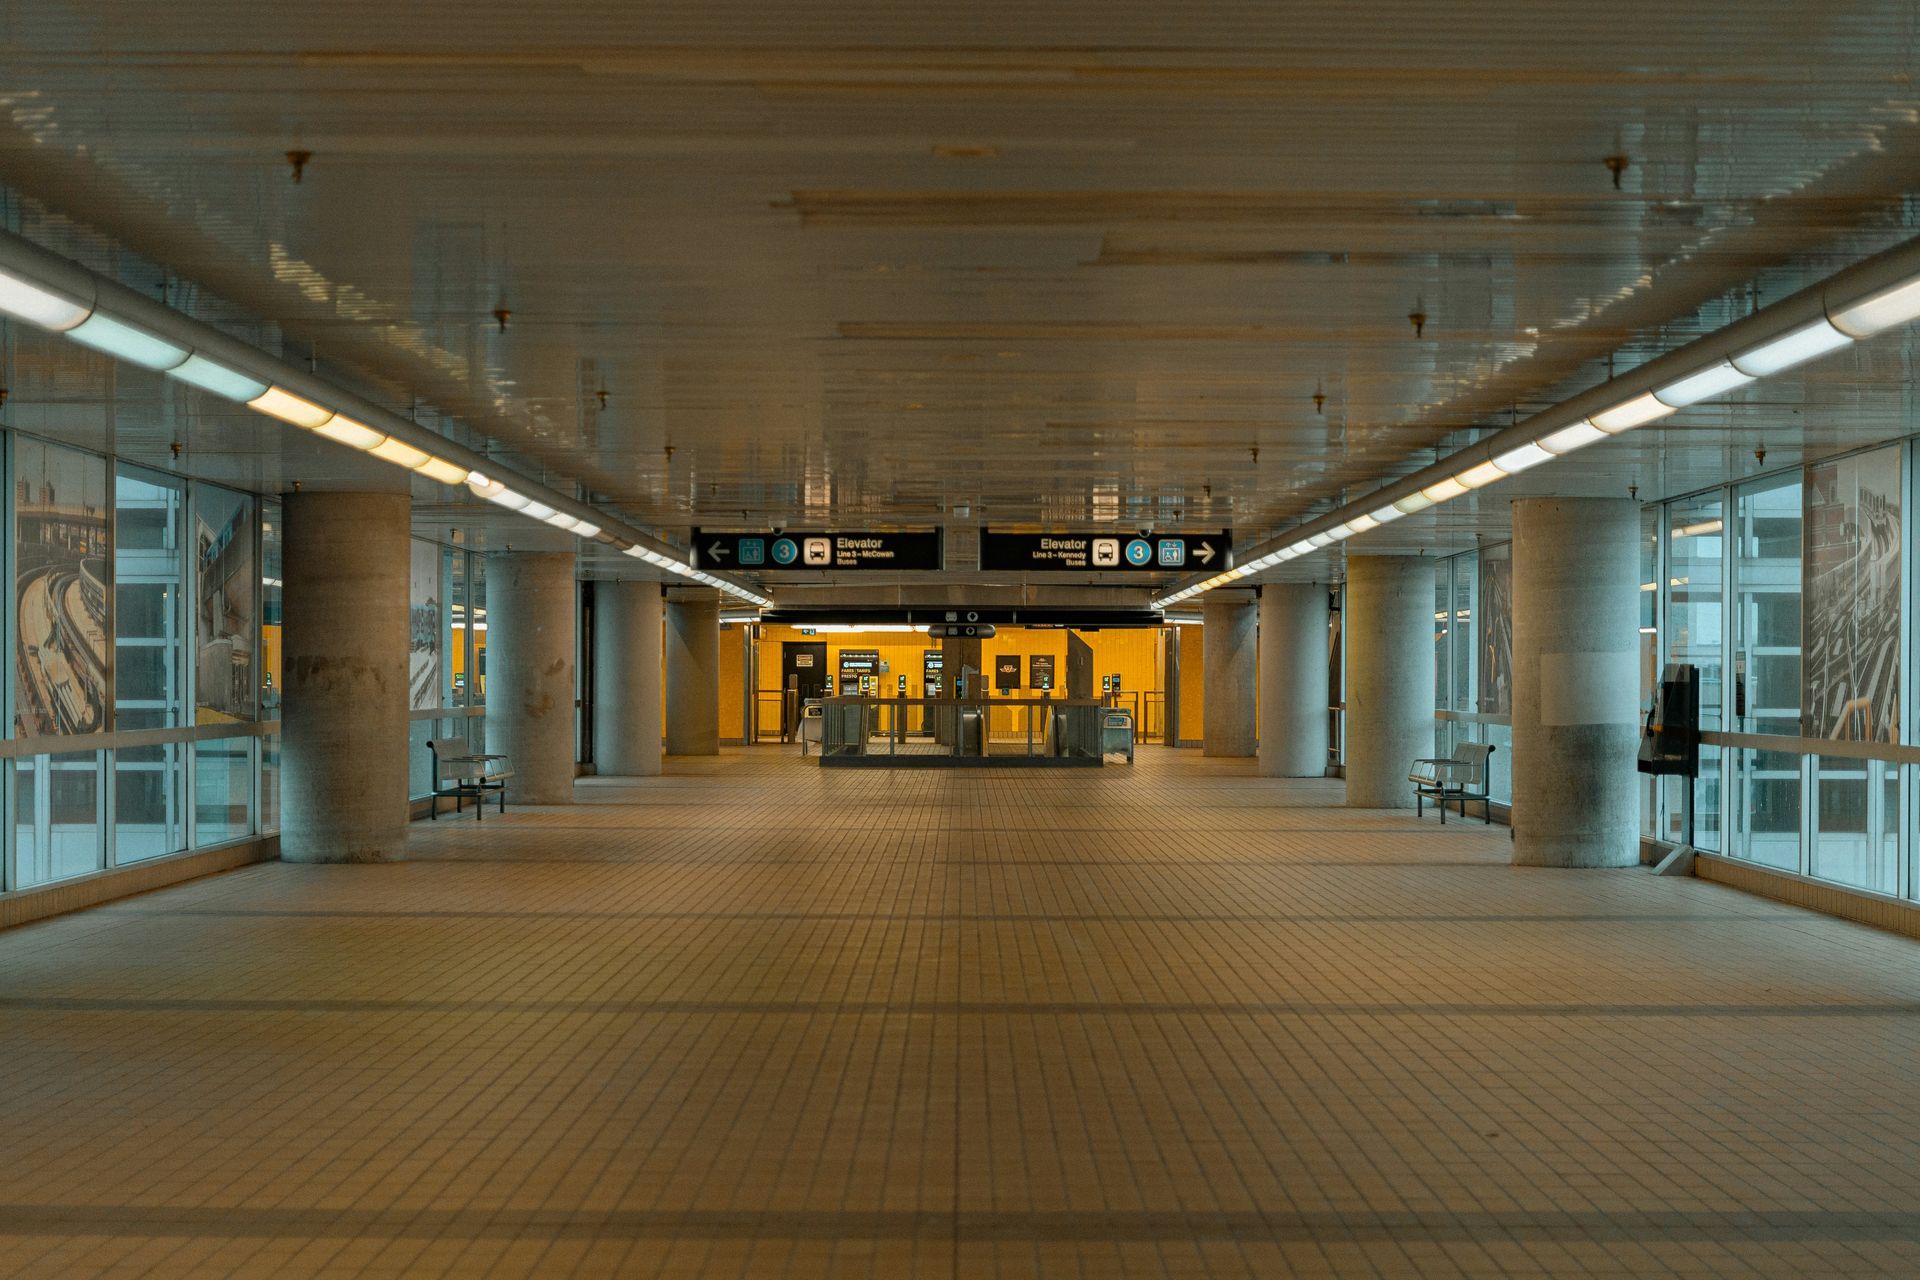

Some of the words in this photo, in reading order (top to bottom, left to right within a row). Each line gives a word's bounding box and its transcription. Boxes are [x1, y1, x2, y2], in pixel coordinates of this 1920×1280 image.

[837, 538, 883, 549] Elevator
[1041, 538, 1086, 549] Elevator
[780, 545, 789, 558] 3
[1134, 546, 1144, 559] 3
